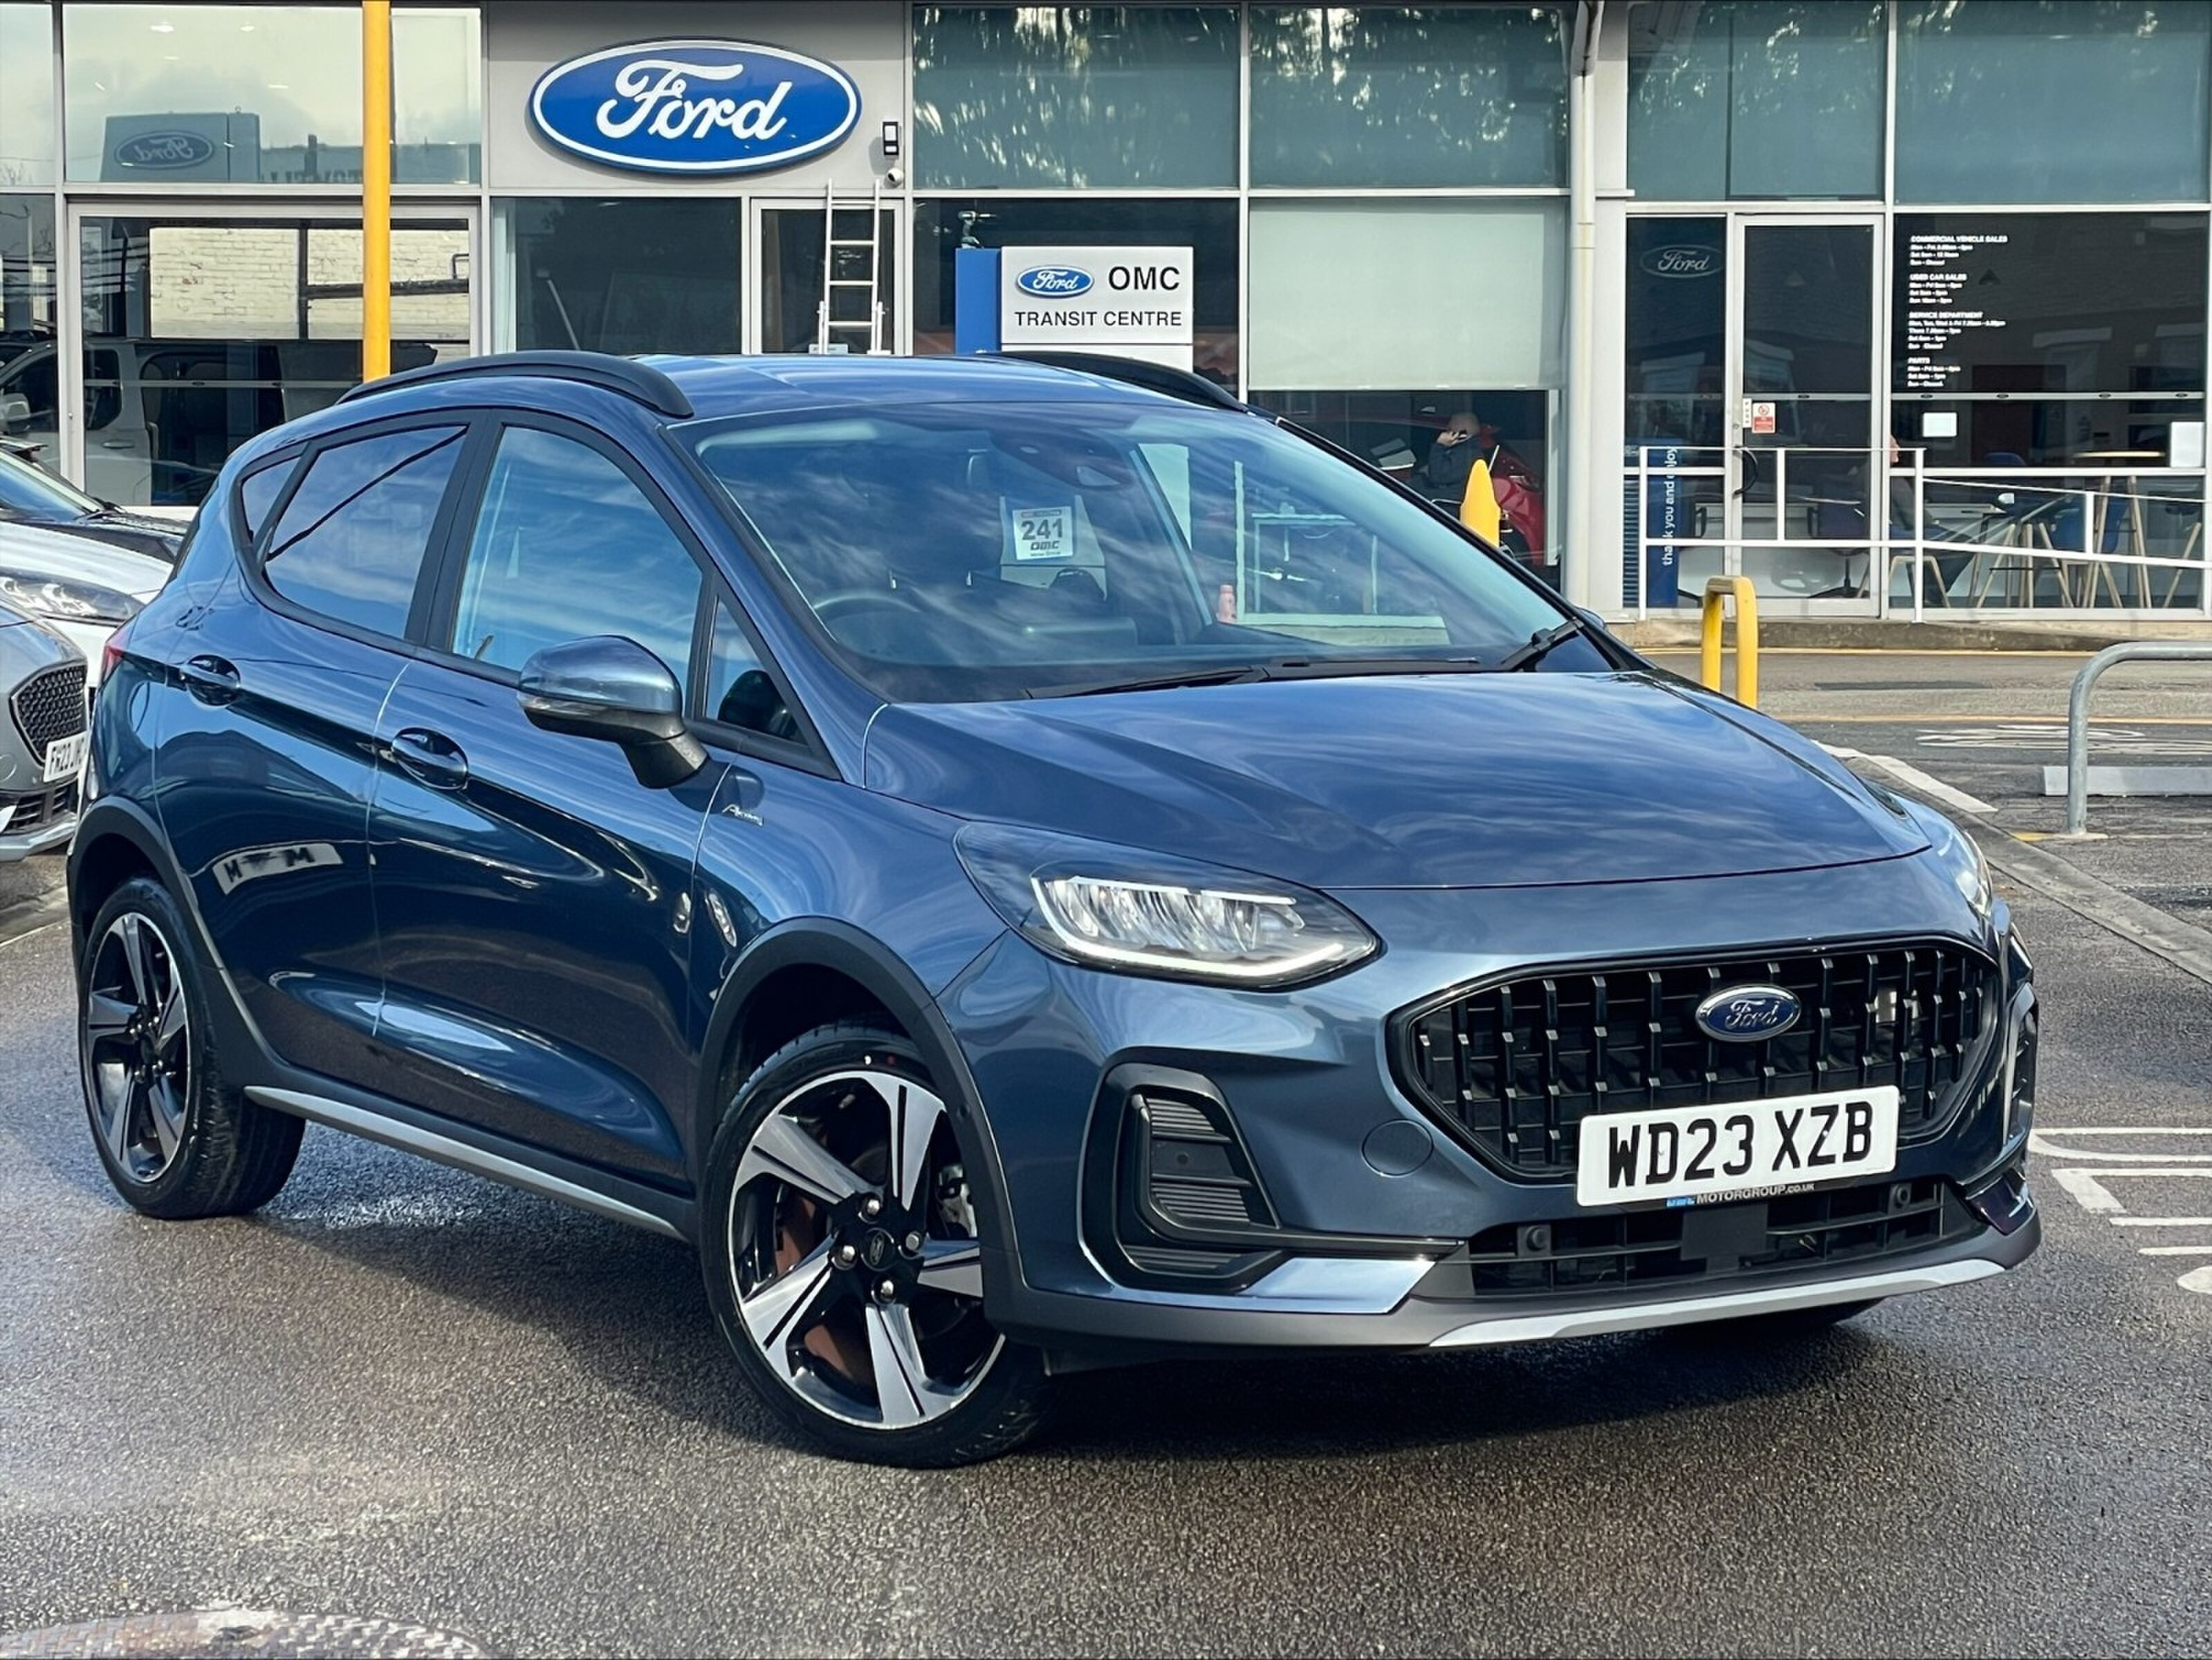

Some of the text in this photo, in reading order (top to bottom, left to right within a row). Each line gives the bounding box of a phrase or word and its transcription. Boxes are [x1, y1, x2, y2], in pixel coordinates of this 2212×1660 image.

[596, 59, 792, 140] Ford
[1657, 249, 1710, 270] Ford
[1032, 266, 1180, 290] Ford OMC
[1015, 311, 1181, 326] TRANSIT CENTRE
[1664, 481, 1675, 505] and
[1021, 518, 1063, 540] 241
[1665, 507, 1675, 528] you
[1662, 531, 1673, 566] thak
[1725, 999, 1780, 1029] Ford
[1608, 1100, 1873, 1188] WD23 XZB
